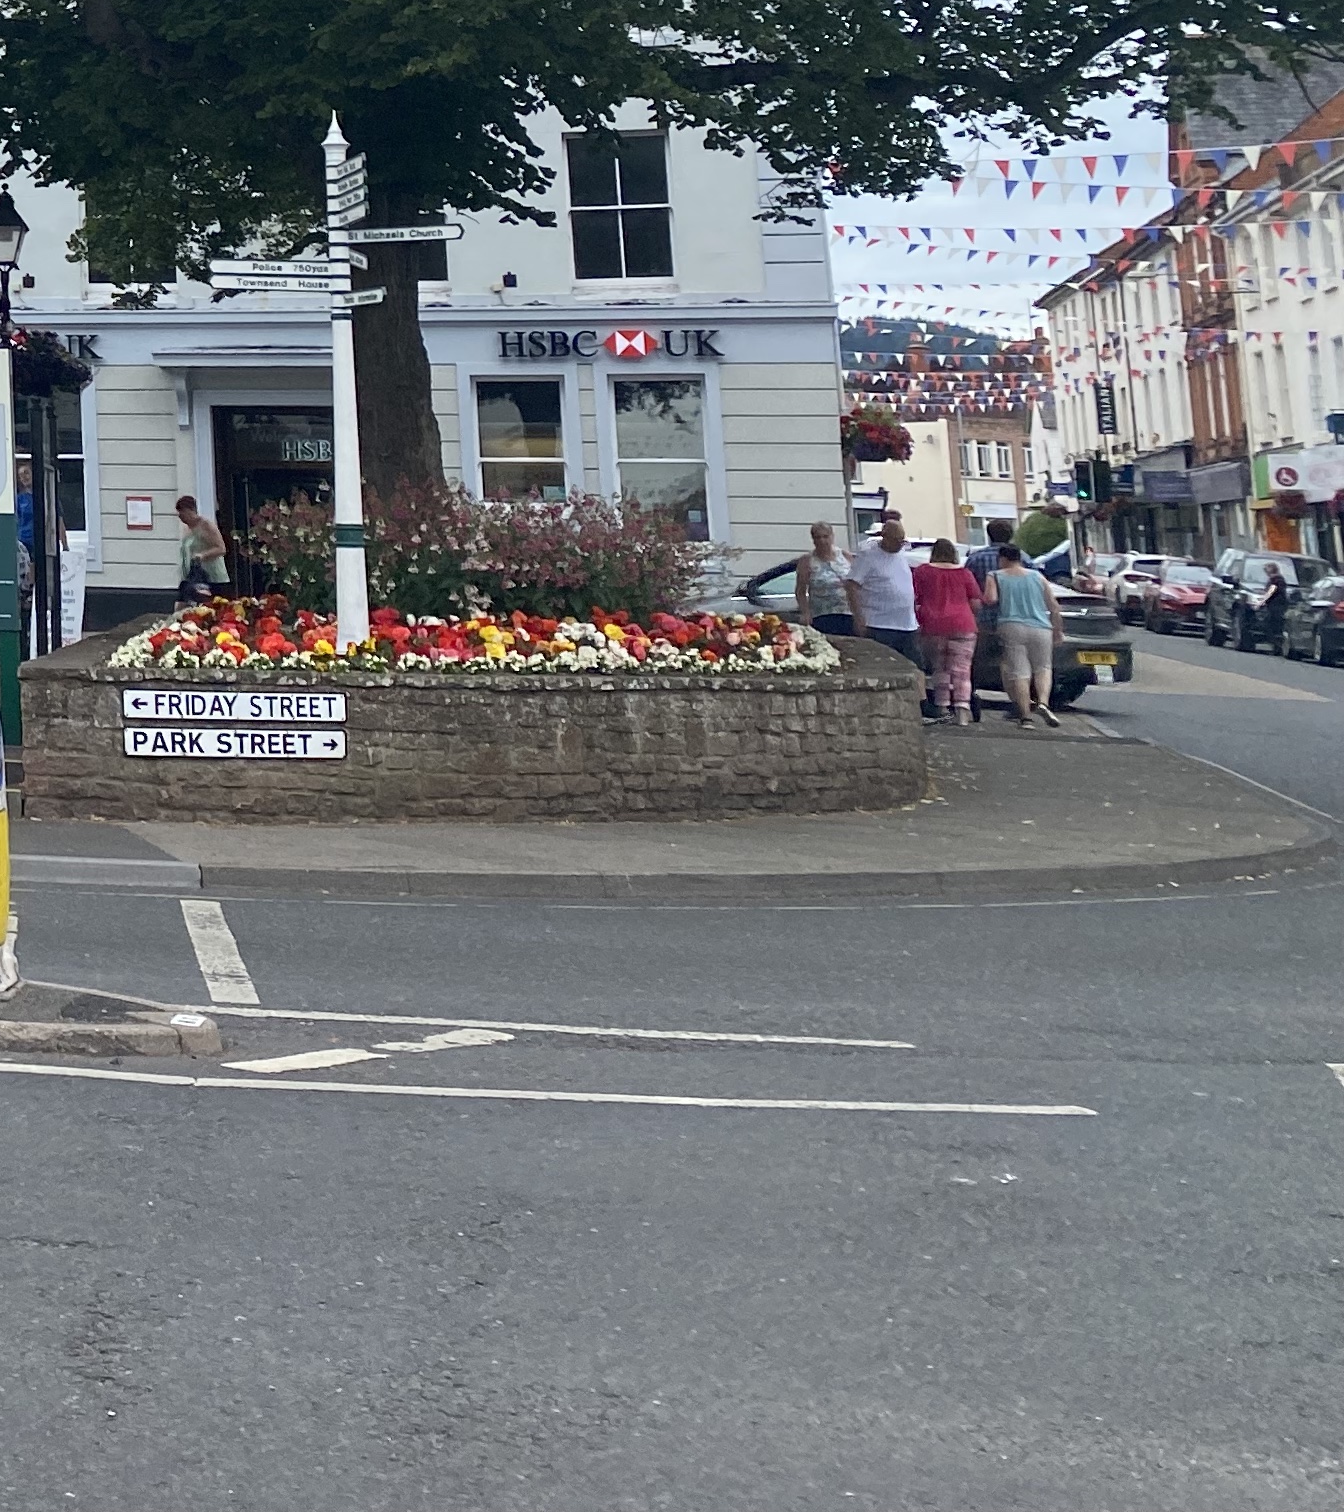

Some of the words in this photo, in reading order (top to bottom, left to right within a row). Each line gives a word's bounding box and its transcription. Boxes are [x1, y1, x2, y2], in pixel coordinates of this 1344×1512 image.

[409, 229, 443, 238] Church
[252, 262, 283, 272] Police
[236, 278, 288, 288] Townsend
[298, 280, 330, 289] House
[498, 330, 599, 358] HSBC
[662, 329, 725, 357] UK
[281, 439, 332, 462] HSB
[154, 693, 238, 717] FRIDAY
[249, 695, 337, 719] STREET
[133, 731, 205, 754] PARK
[217, 732, 313, 755] STREET
